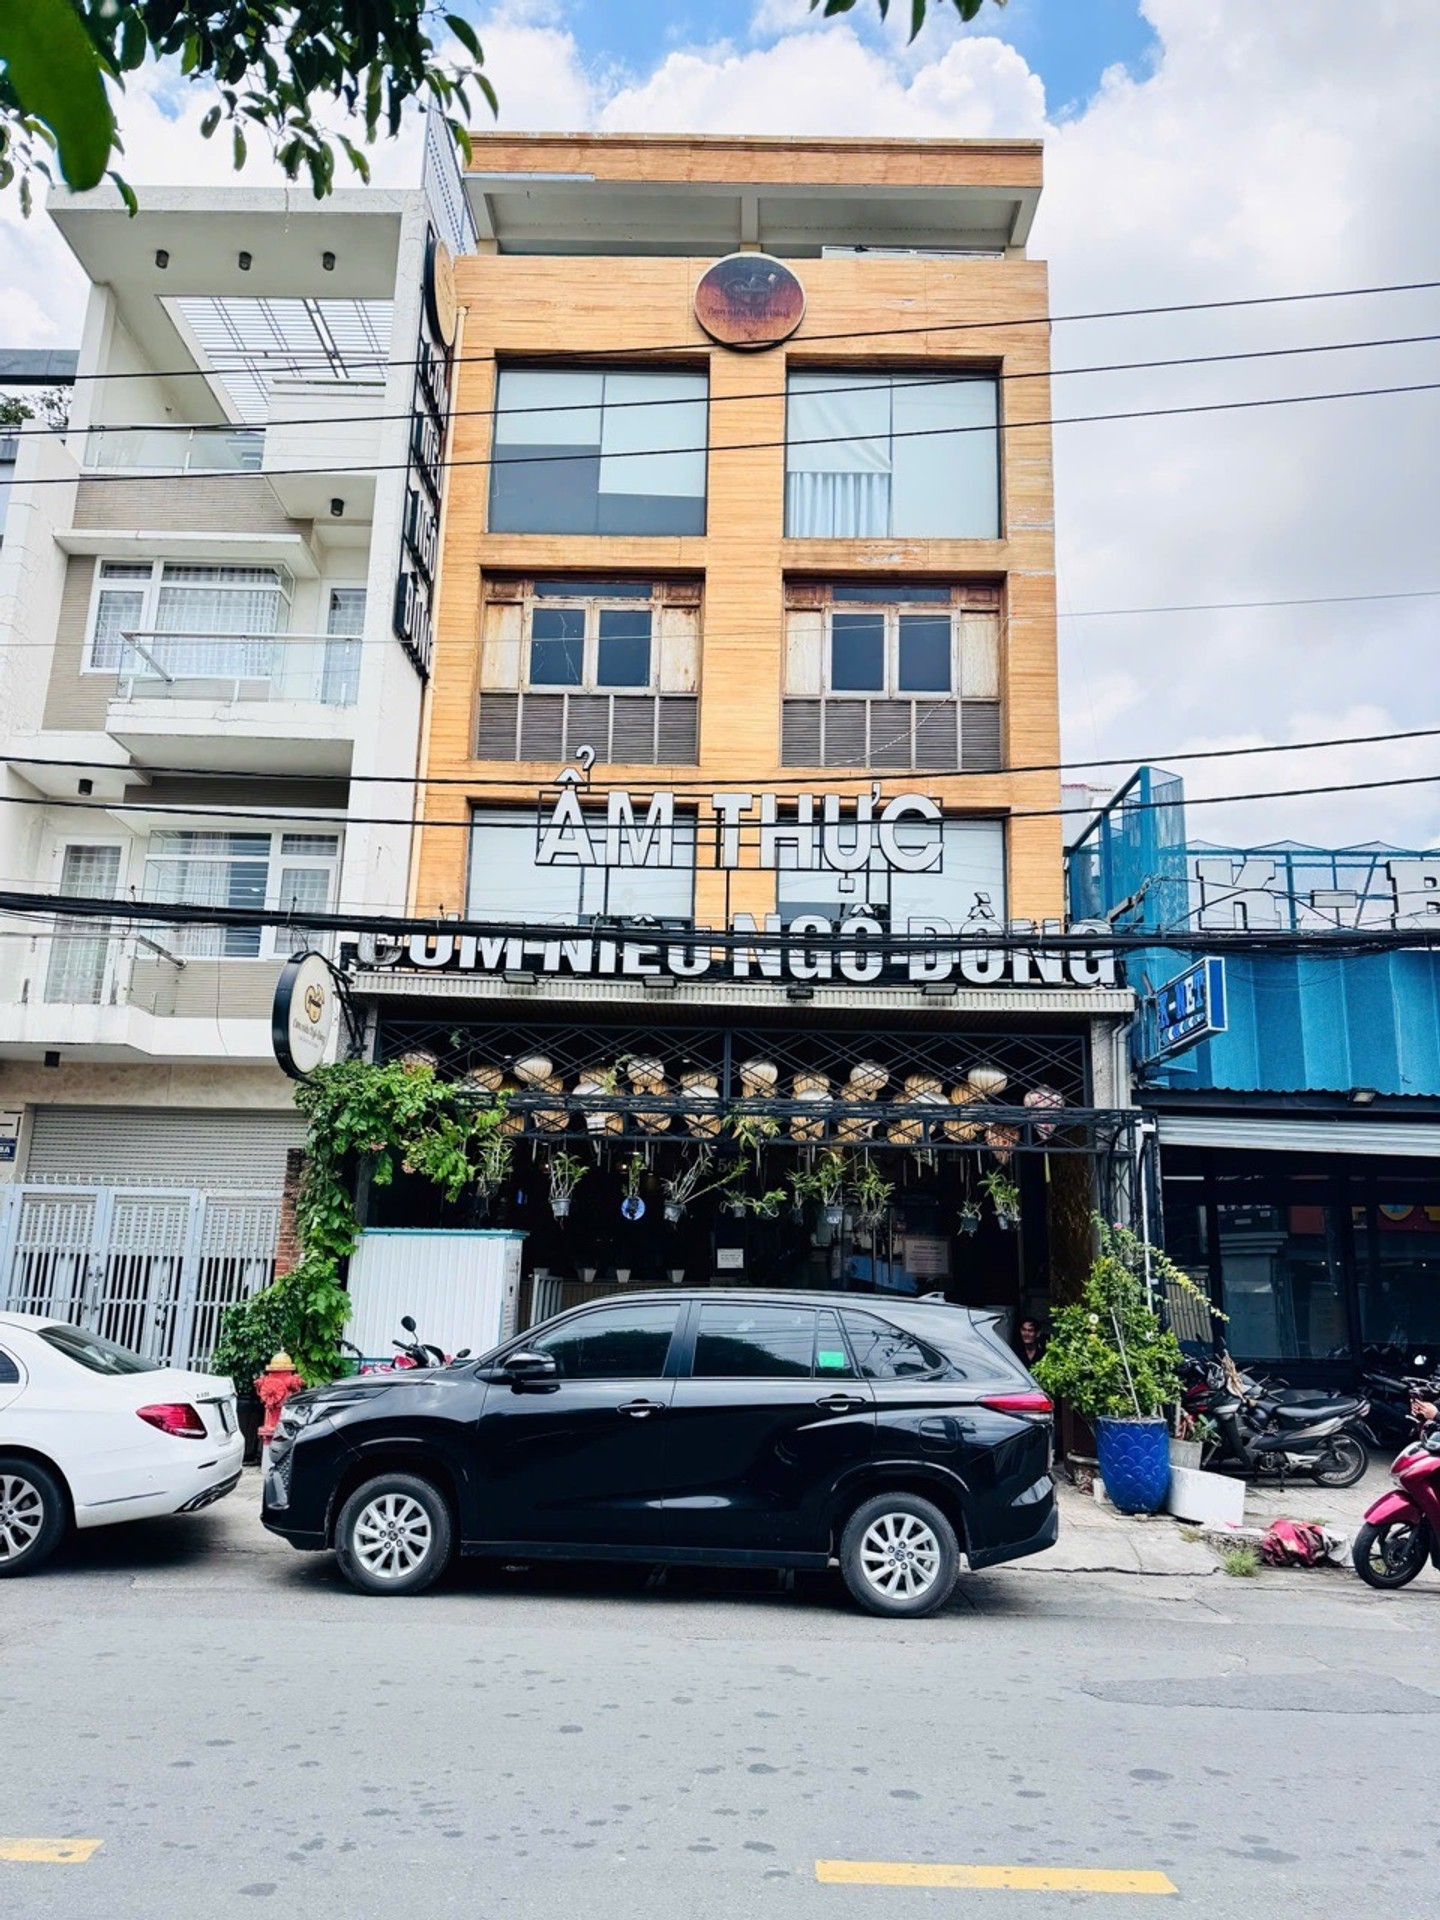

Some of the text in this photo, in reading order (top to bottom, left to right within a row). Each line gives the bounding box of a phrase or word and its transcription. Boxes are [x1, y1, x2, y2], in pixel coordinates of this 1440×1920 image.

[536, 744, 943, 893] ẨM THỰC
[733, 904, 883, 982] NGÔ
